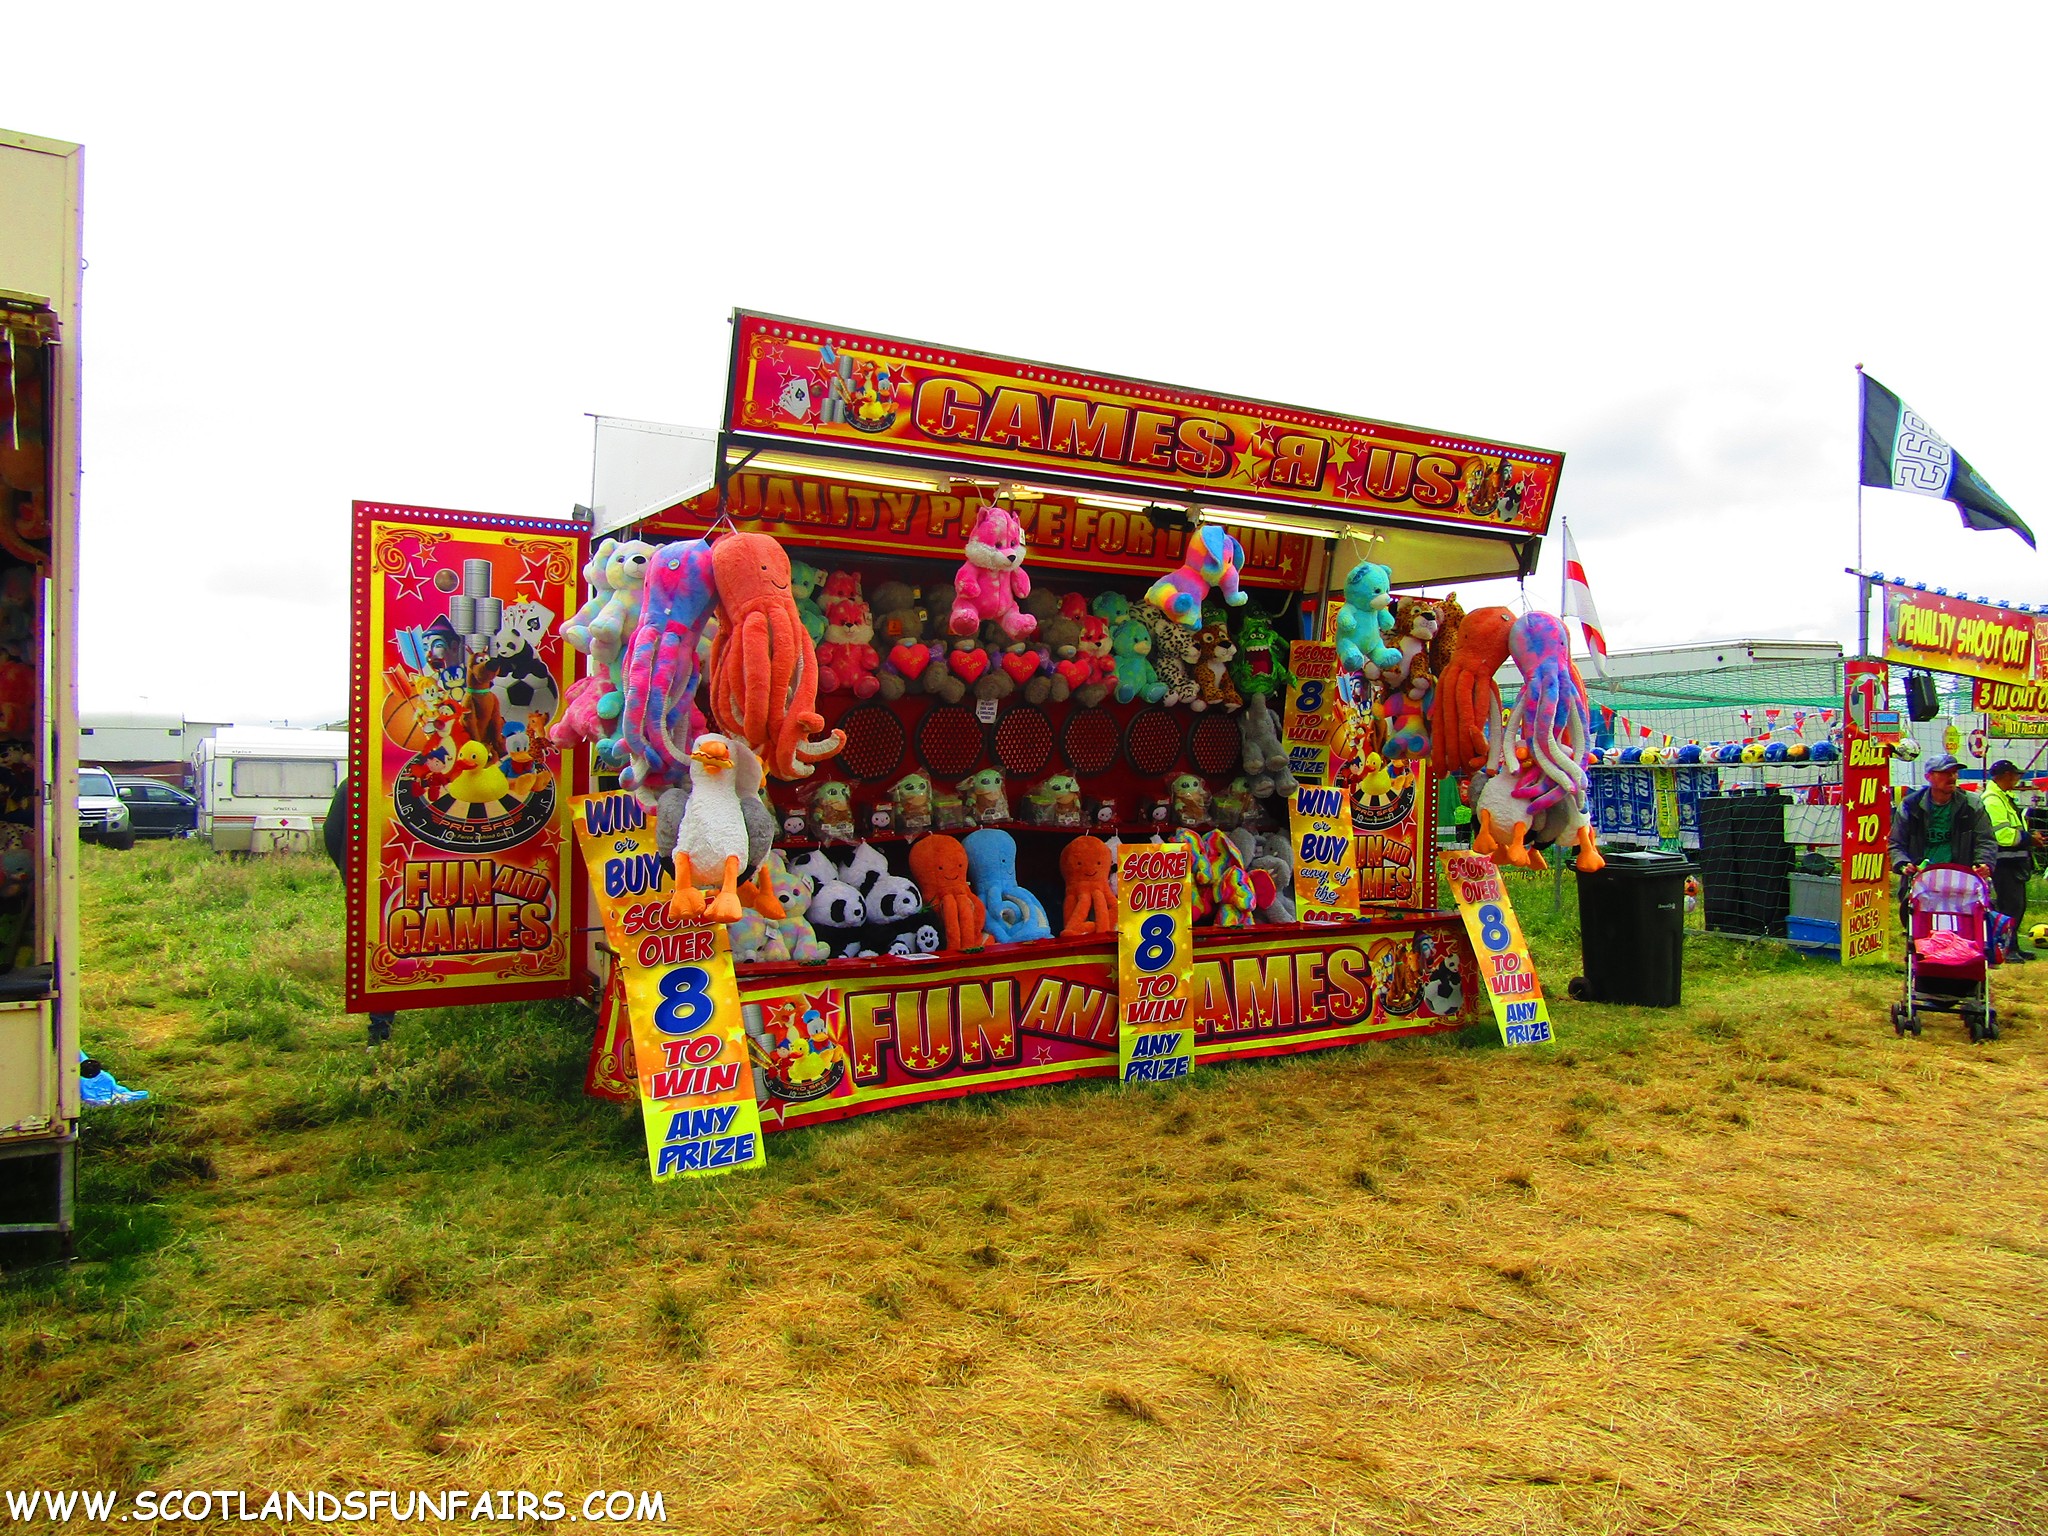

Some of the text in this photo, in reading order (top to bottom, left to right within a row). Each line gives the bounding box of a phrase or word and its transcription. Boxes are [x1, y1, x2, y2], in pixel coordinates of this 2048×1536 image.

[912, 375, 1234, 478] GAMES
[1364, 447, 1459, 507] US
[1072, 507, 1154, 557] FOR
[1897, 603, 1956, 651] PENALTY
[1957, 617, 2003, 661] SHOOT
[2002, 625, 2028, 665] OUT
[1294, 645, 1336, 661] SCORE
[1296, 662, 1331, 678] OVER
[1296, 680, 1324, 712] 8
[1979, 682, 1991, 707] 3
[1993, 684, 2008, 708] IN
[2009, 686, 2037, 709] OUT
[1287, 727, 1327, 741] WIN
[1296, 714, 1322, 727] TO
[1289, 746, 1321, 760] ANY
[1849, 739, 1886, 766] BALL
[1296, 786, 1343, 819] WIN
[1859, 778, 1878, 806] IN
[585, 793, 646, 837] WIN
[1312, 821, 1331, 832] or
[1858, 814, 1879, 843] TO
[614, 838, 639, 853] or
[1300, 833, 1348, 866] BUY
[1354, 834, 1411, 868] UN AND
[604, 850, 664, 898] BUY
[1123, 851, 1187, 881] SCORE
[1300, 866, 1351, 886] any of
[1447, 855, 1496, 880] SCORE
[1851, 852, 1884, 881] WIN
[404, 860, 550, 908] FUN AND
[1129, 882, 1182, 911] OVER
[1314, 886, 1339, 904] the
[1461, 879, 1500, 904] OVER
[1853, 888, 1872, 912] ANY
[388, 903, 552, 956] GAMES
[1478, 904, 1510, 951] 8
[1849, 908, 1880, 936] HOLE'S
[637, 930, 715, 968] OVER
[1134, 913, 1176, 972] 8
[1849, 929, 1883, 959] A GOAL!
[1491, 953, 1520, 974] TO
[1137, 973, 1178, 999] TO
[1491, 972, 1533, 995] WIN
[653, 966, 714, 1035] 8
[848, 979, 1018, 1081] FUN
[1194, 948, 1371, 1034] AMES
[1126, 998, 1187, 1025] WIN
[1506, 1002, 1538, 1024] ANY
[1132, 1032, 1181, 1058] ANY
[1506, 1022, 1551, 1046] PRIZE
[661, 1035, 722, 1068] TO
[651, 1062, 740, 1100] WIN
[1124, 1056, 1189, 1084] PRIZE
[665, 1104, 739, 1143] ANY
[656, 1132, 756, 1177] PRIZE
